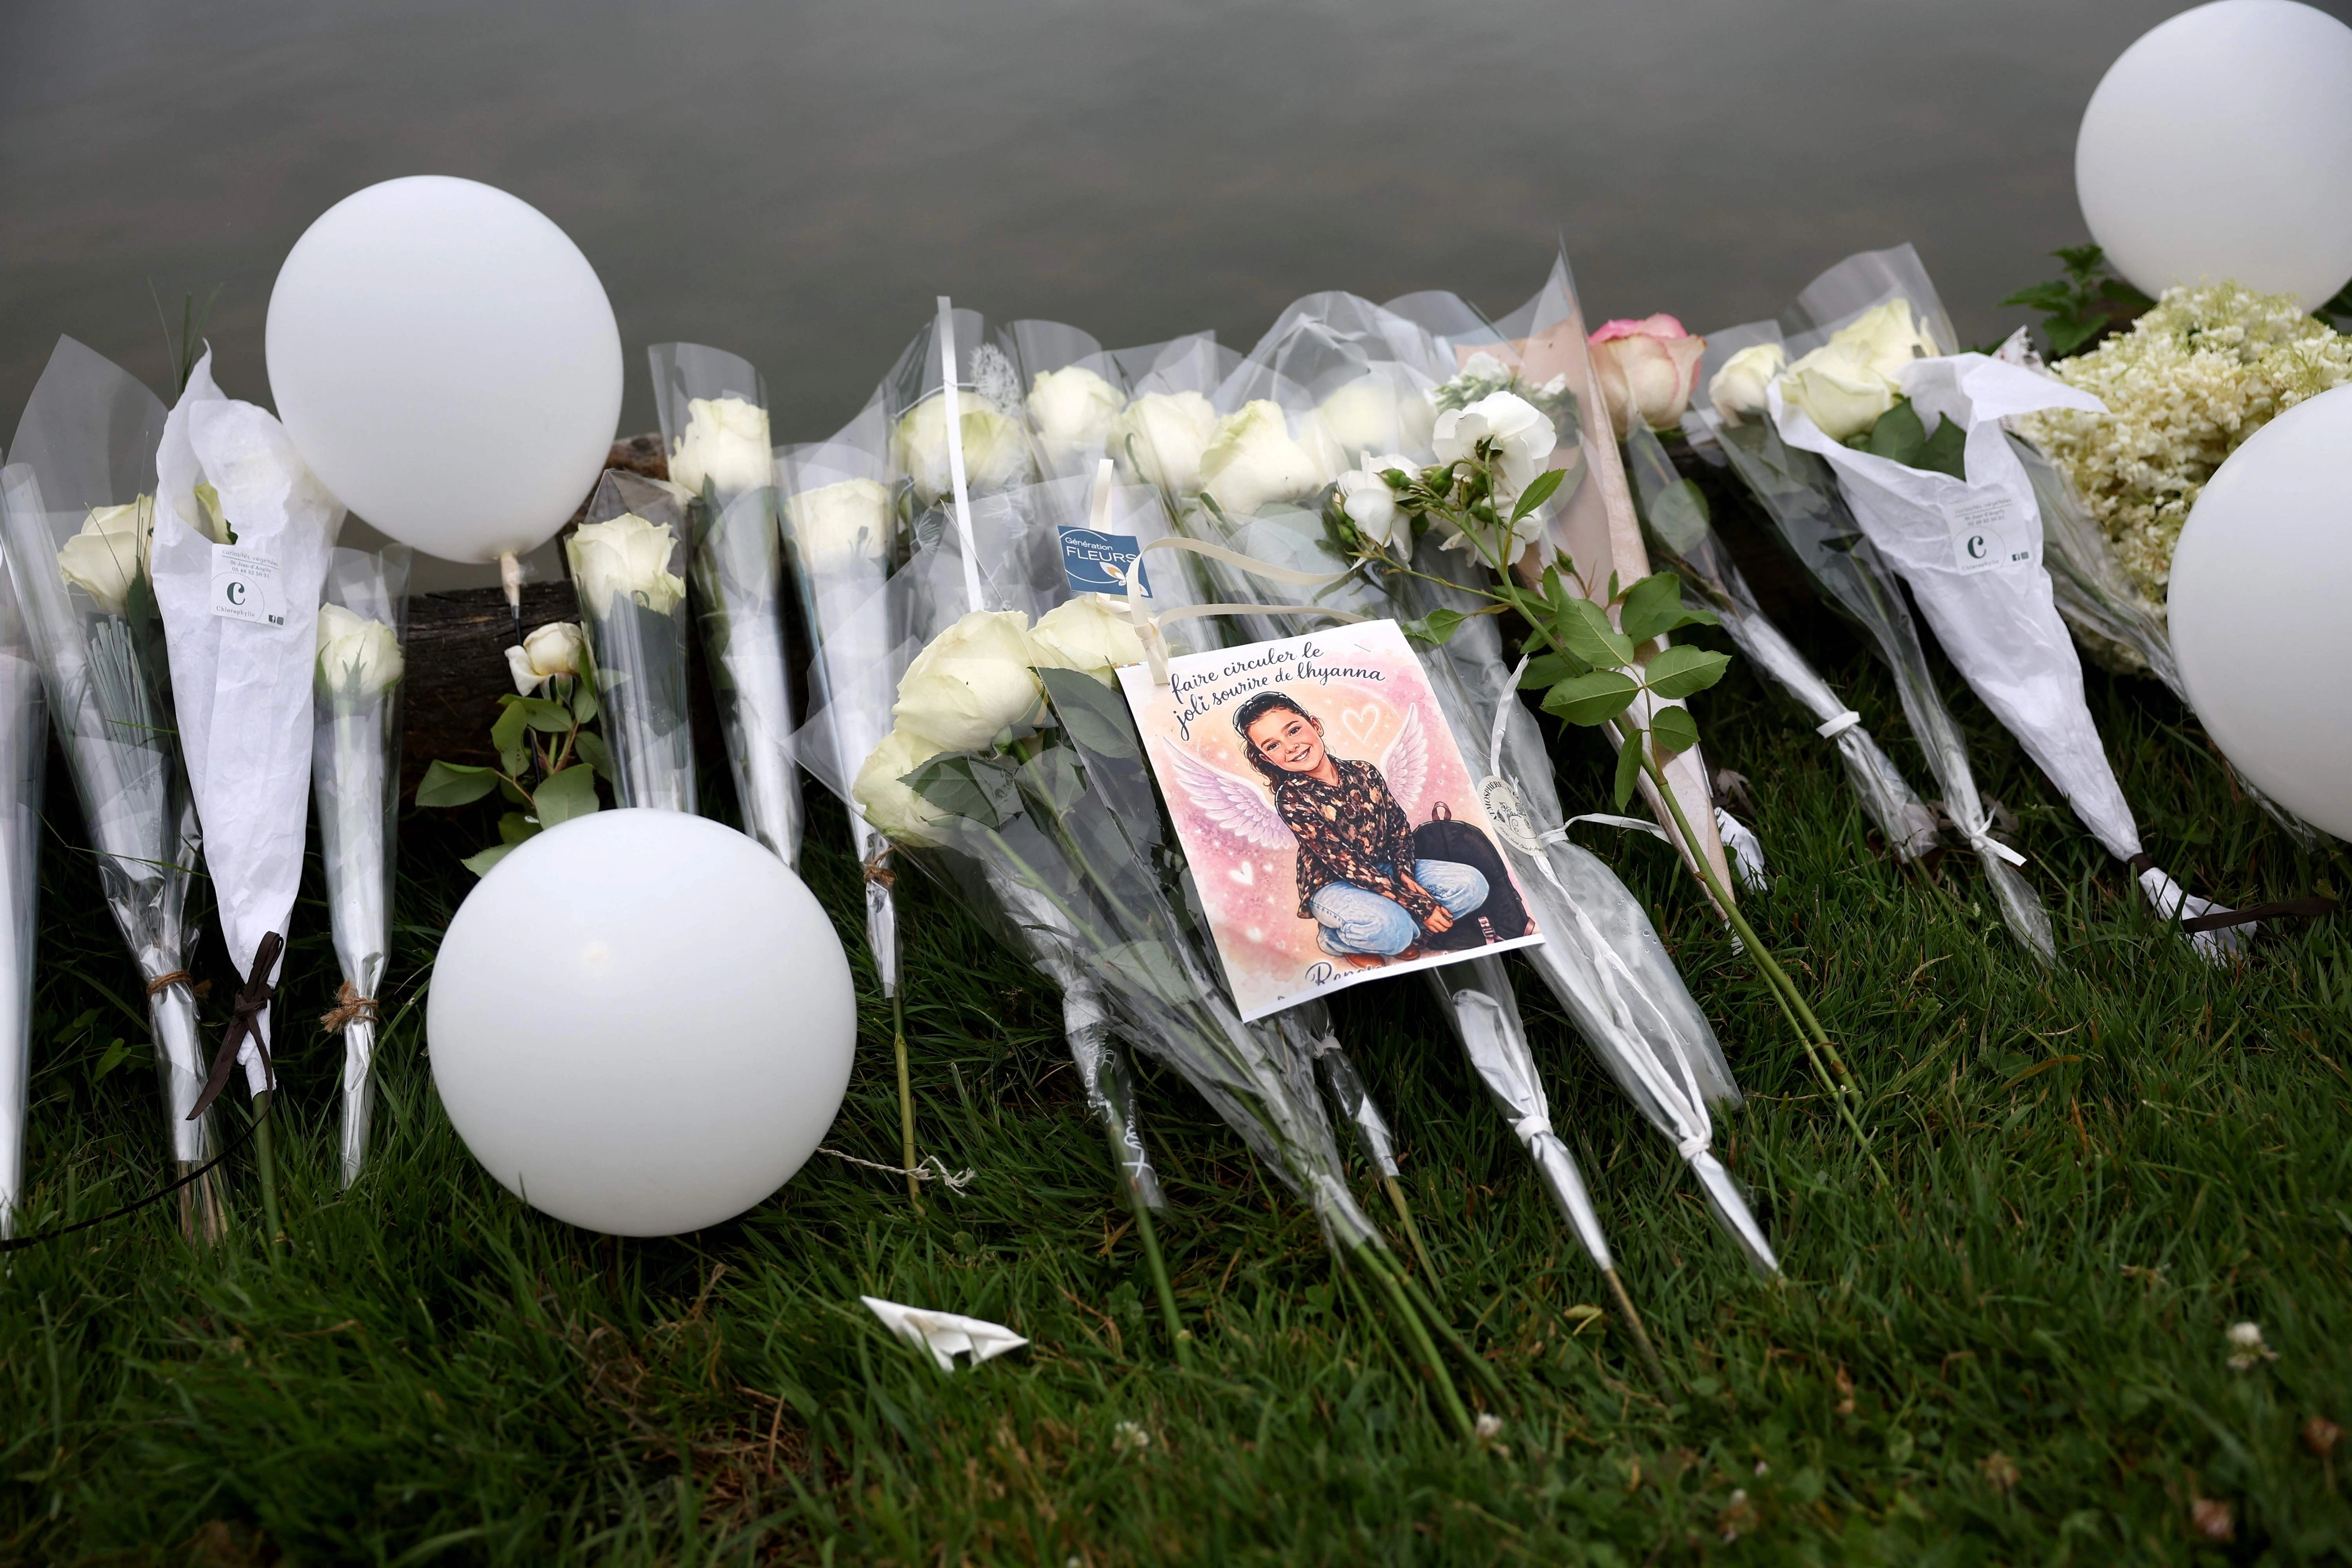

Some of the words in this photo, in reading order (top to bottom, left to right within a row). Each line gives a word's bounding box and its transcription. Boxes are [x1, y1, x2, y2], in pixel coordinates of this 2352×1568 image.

[1065, 536, 1114, 551] Génération
[1066, 546, 1137, 564] FLEURS
[1170, 672, 1220, 705] faire
[1223, 647, 1298, 676] circuler
[1301, 641, 1324, 658] le
[1174, 694, 1210, 741] joli
[1212, 676, 1271, 706] sourire
[1275, 667, 1294, 683] de
